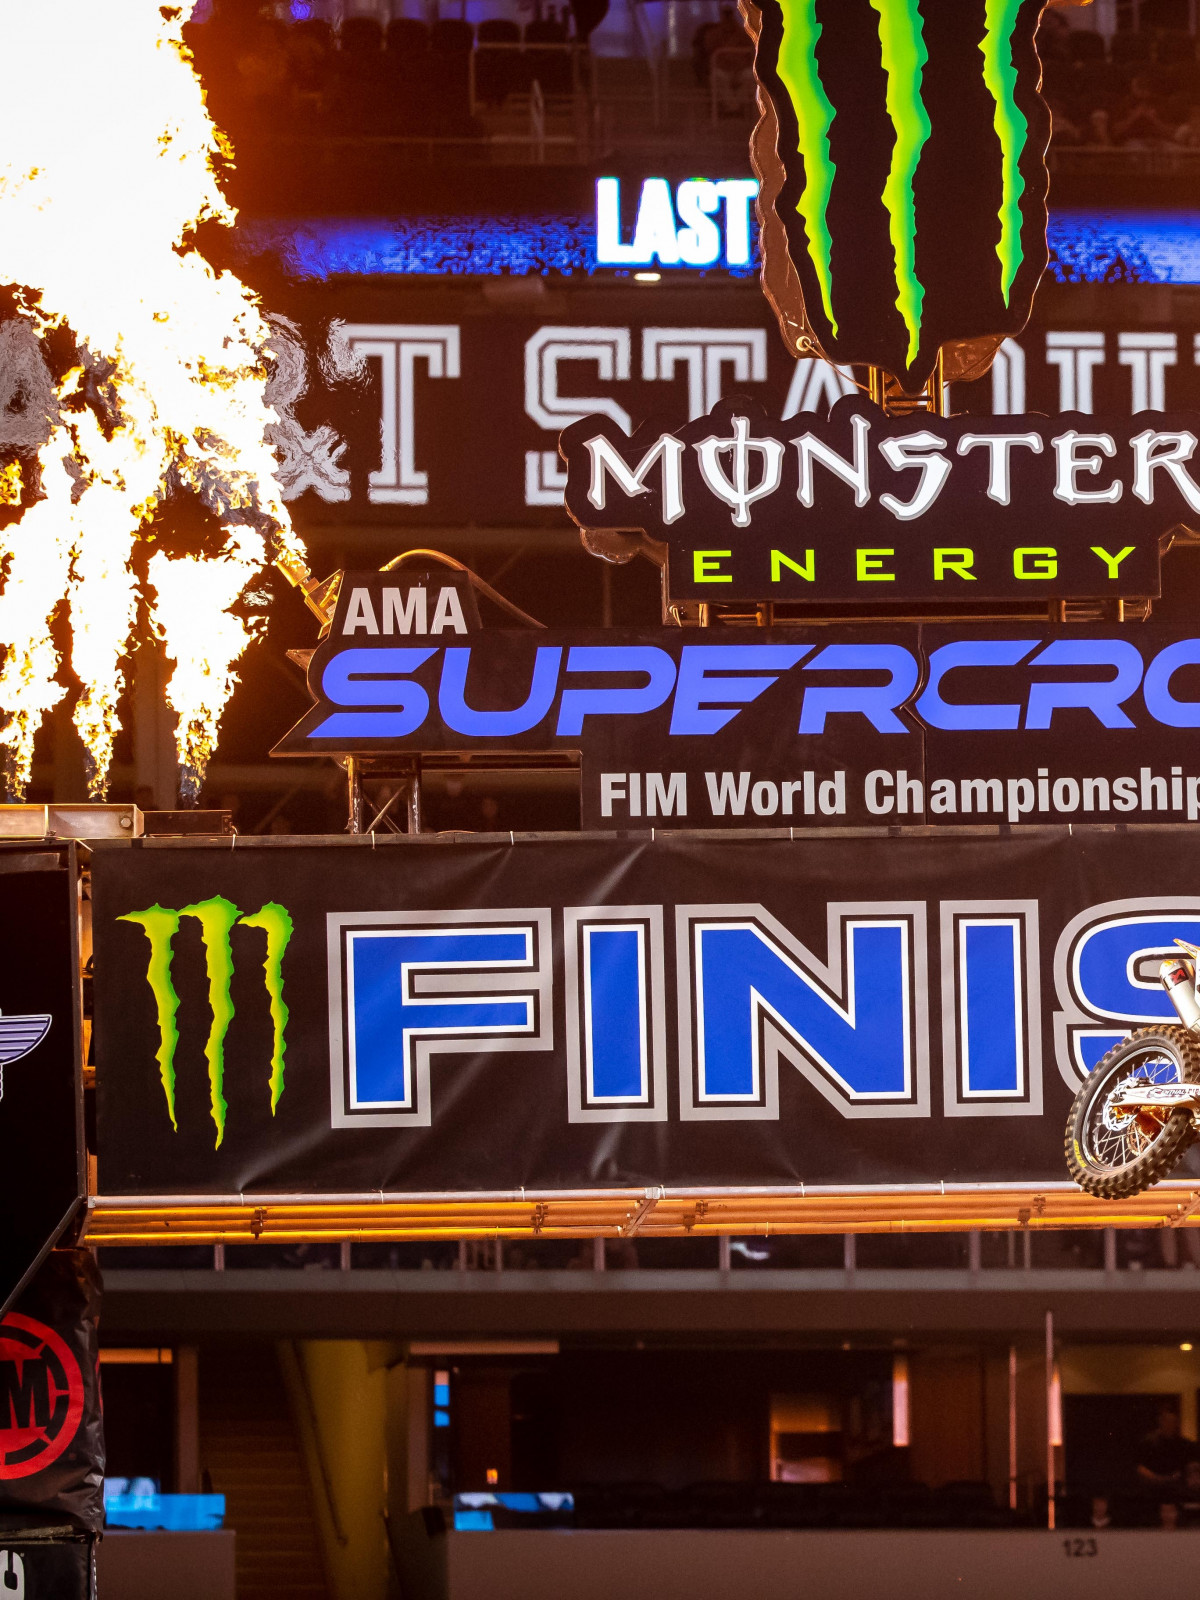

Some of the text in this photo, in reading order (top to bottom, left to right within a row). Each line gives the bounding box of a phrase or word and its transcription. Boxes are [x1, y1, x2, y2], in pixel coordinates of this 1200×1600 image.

[596, 176, 760, 265] LAST
[693, 546, 1136, 583] ENERGY
[342, 586, 468, 635] AMA
[600, 772, 688, 817] FIM
[704, 770, 846, 817] World
[1063, 1538, 1098, 1558] 123
